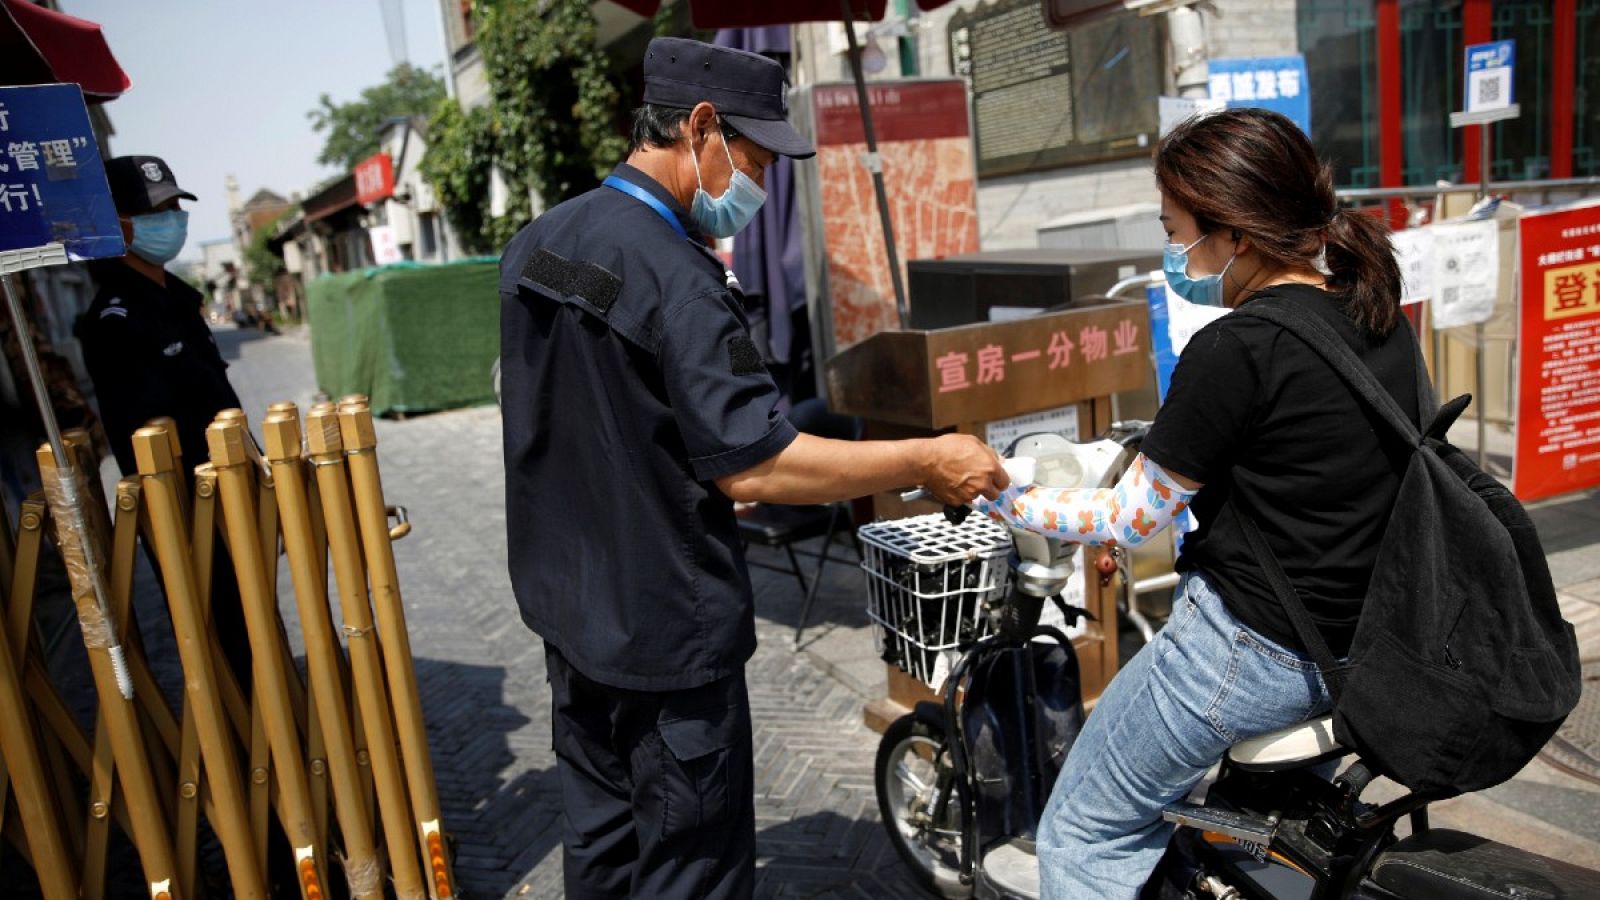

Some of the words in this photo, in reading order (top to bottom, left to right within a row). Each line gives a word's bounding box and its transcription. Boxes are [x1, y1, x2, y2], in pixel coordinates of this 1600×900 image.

[1552, 268, 1600, 312] 登
[936, 320, 1139, 393] 宣房一分物业
